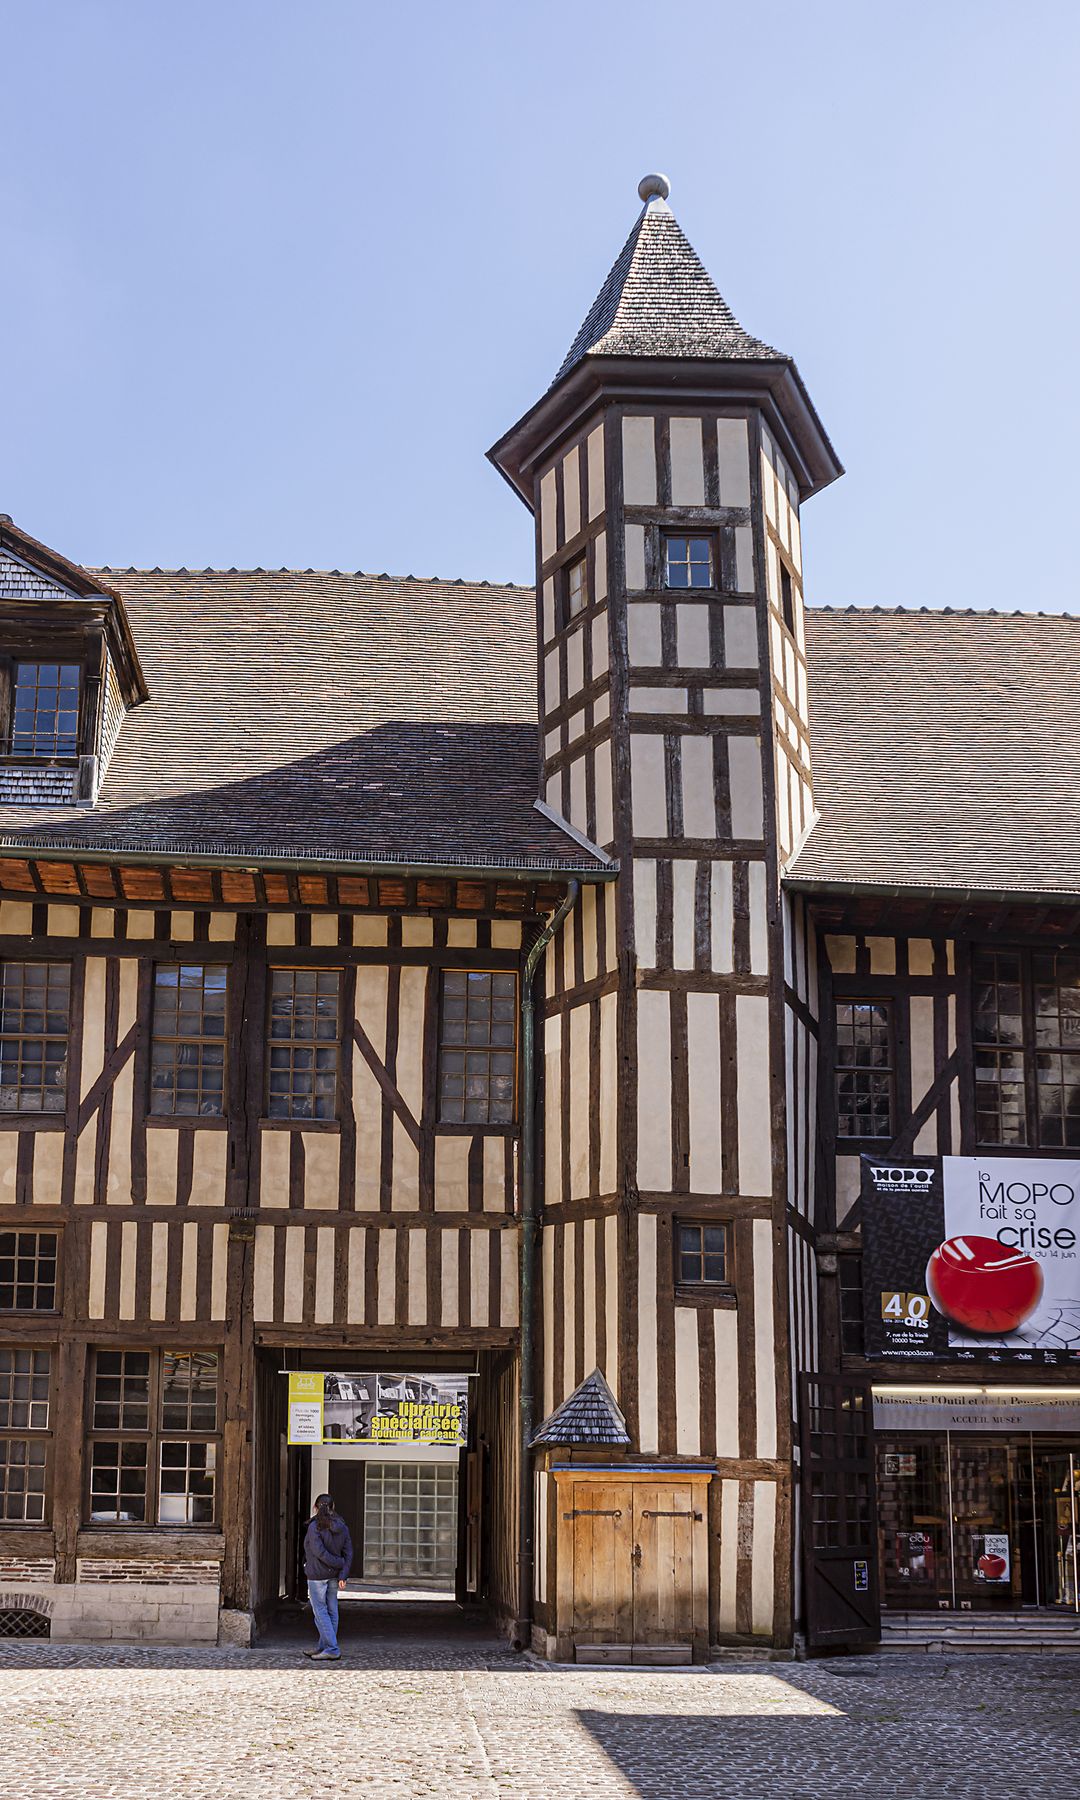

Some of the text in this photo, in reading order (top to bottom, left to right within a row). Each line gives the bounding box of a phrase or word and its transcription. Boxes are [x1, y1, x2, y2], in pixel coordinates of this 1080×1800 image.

[875, 1169, 929, 1182] MOPO
[979, 1170, 991, 1181] la
[979, 1182, 1075, 1206] MOPO
[980, 1204, 1037, 1220] fait sa
[996, 1221, 1077, 1249] crise
[1049, 1250, 1058, 1258] 14
[1061, 1250, 1077, 1260] juin
[884, 1294, 927, 1319] 40
[904, 1317, 929, 1329] ans
[874, 1395, 912, 1405] Maison
[916, 1395, 928, 1406] de
[931, 1396, 965, 1405] l'Outil
[968, 1397, 978, 1406] et
[398, 1401, 461, 1417] librairie
[371, 1414, 460, 1431] spécialisée
[951, 1415, 1023, 1424] ACCUEIL MUSÉE
[371, 1428, 413, 1439] boutique
[420, 1430, 460, 1439] cadeaux
